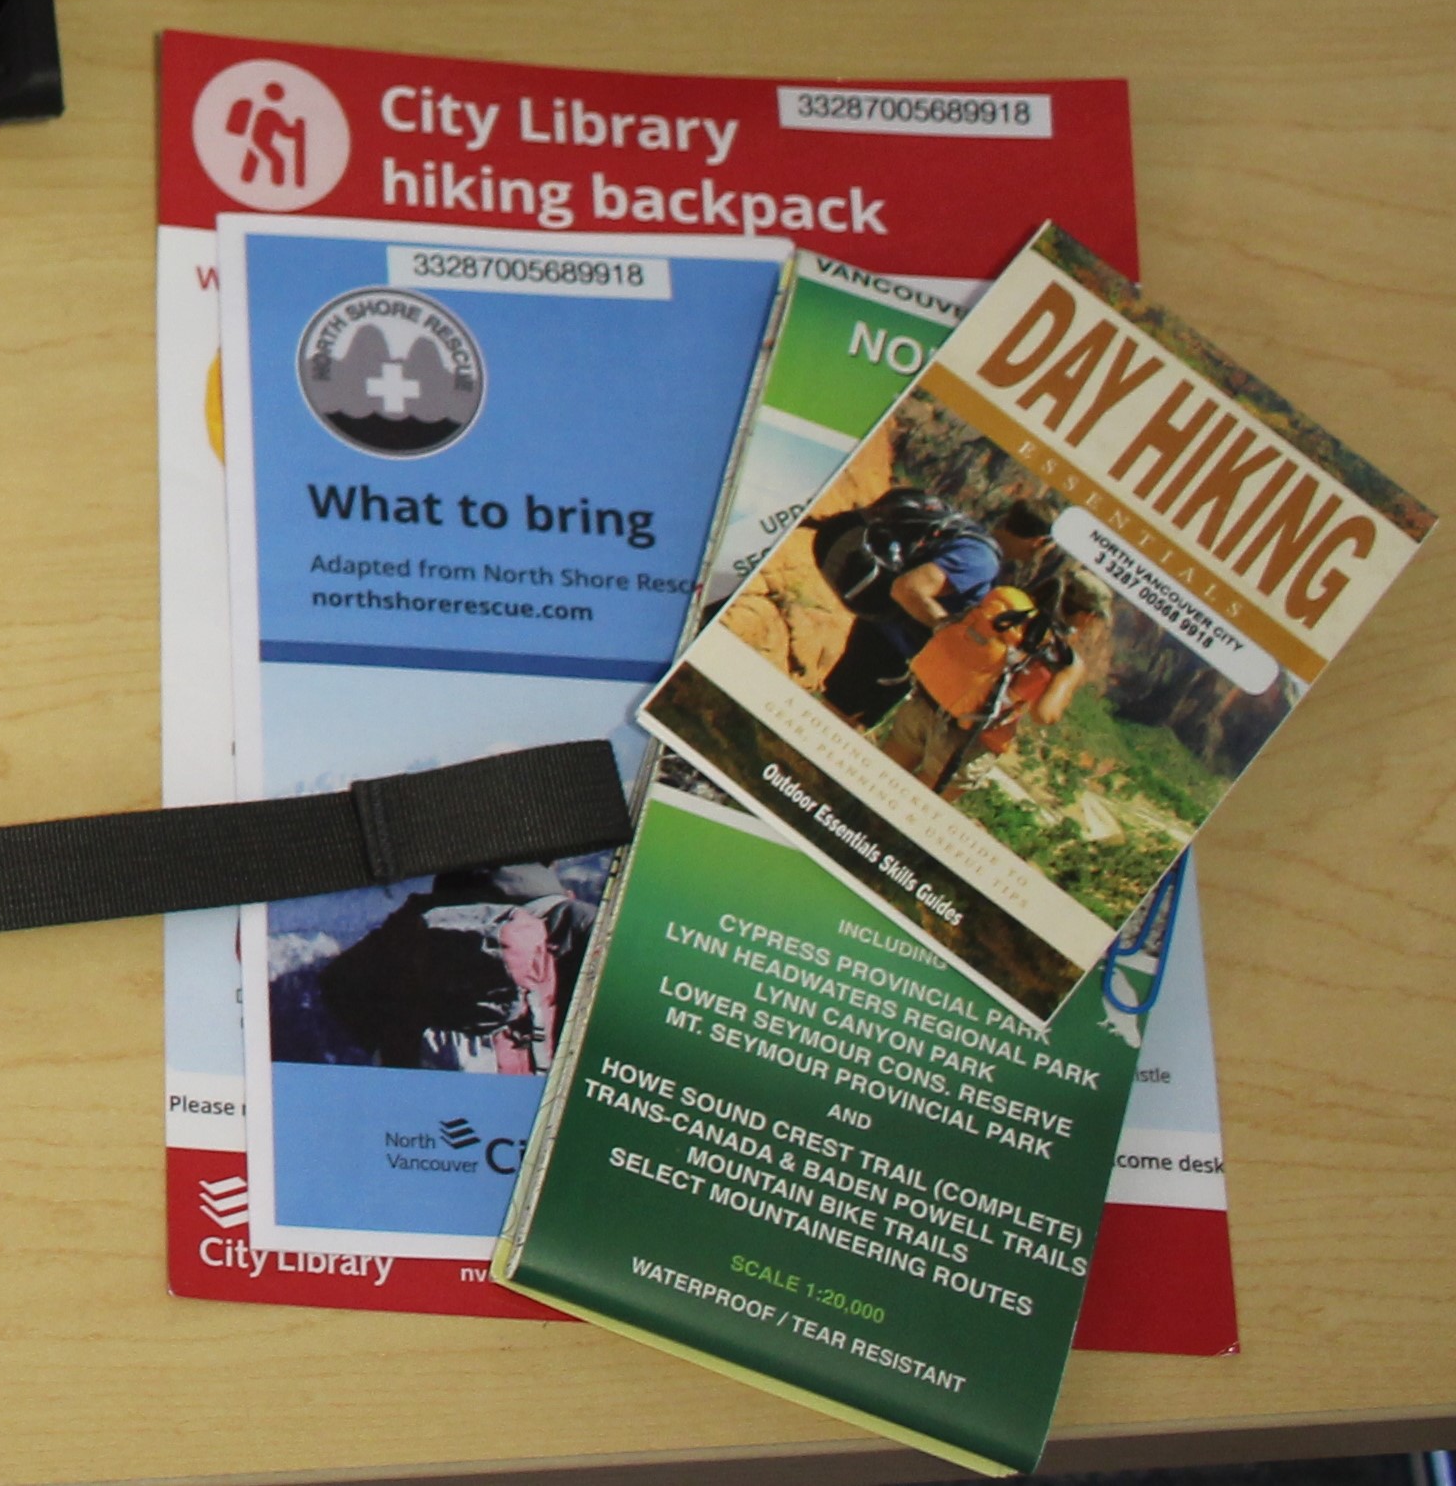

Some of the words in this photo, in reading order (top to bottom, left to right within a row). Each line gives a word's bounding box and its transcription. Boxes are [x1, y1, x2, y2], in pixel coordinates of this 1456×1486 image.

[379, 85, 501, 152] City
[520, 97, 740, 166] Library
[796, 92, 1032, 126] 33287005689918
[383, 157, 576, 230] hiking
[592, 172, 888, 236] backpack
[412, 251, 645, 288] 33287005689918
[343, 298, 424, 324] SHORE
[422, 314, 476, 393] RESCUE
[975, 278, 1167, 450] DAY
[1106, 377, 1378, 632] HIKING
[307, 483, 443, 527] What
[457, 491, 509, 530] to
[525, 493, 657, 549] bring
[1016, 439, 1243, 618] ESSENTIALS
[310, 554, 410, 581] Adapted
[419, 557, 476, 581] from
[482, 562, 554, 587] North
[560, 567, 630, 591] Shore
[311, 587, 594, 622] northshorerescue.com
[1089, 528, 1135, 568] NORTH
[1134, 563, 1213, 630] VANCOUVER
[1211, 625, 1245, 652] CITY
[1094, 551, 1107, 565] 3
[1104, 562, 1140, 590] 3287
[761, 762, 819, 813] Outdoor
[812, 802, 883, 865] Essentials
[877, 852, 920, 893] Skills
[914, 881, 965, 928] Guides
[665, 920, 730, 960] LYNN
[732, 945, 900, 1020] HEADWATERS
[903, 1006, 1028, 1067] REGIONAL
[1033, 1052, 1102, 1092] PARK
[718, 912, 832, 968] CYPRESS
[835, 954, 980, 1023] PROVINCIAL
[658, 974, 749, 1022] LOWER
[752, 1009, 873, 1069] SEYMOUR
[877, 1055, 952, 1097] CONS.
[957, 1082, 1074, 1139] RESERVE
[753, 981, 819, 1020] LYNN
[822, 1006, 927, 1059] CANYON
[929, 1044, 998, 1084] PARK
[169, 1095, 235, 1116] Please
[664, 1005, 704, 1037] MT.
[708, 1021, 831, 1081] SEYMOUR
[833, 1067, 981, 1136] PROVINCIAL
[985, 1120, 1055, 1161] PARK
[826, 1102, 873, 1131] AND
[384, 1131, 437, 1150] North
[386, 1153, 479, 1173] Vancouver
[584, 1077, 774, 1165] TRANS-CANADA
[778, 1150, 797, 1173] &
[802, 1158, 890, 1206] BADEN
[892, 1191, 996, 1246] POWELL
[1001, 1230, 1089, 1278] TRAILS
[600, 1055, 678, 1100] HOWE
[680, 1085, 768, 1132] SOUND
[771, 1119, 856, 1164] CREST
[859, 1149, 929, 1193] TRAIL
[933, 1176, 1084, 1250] (COMPLETE)
[1178, 1154, 1226, 1175] desk
[608, 1146, 706, 1196] SELECT
[708, 1182, 927, 1279] MOUNTAINEERING
[931, 1264, 1035, 1317] ROUTES
[686, 1145, 816, 1208] MOUNTAIN
[818, 1194, 878, 1231] BIKE
[882, 1215, 970, 1264] TRAILS
[198, 1235, 269, 1279] City
[276, 1251, 395, 1287] Library
[729, 1254, 801, 1293] SCALE
[804, 1281, 886, 1325] 1:20,000
[630, 1255, 778, 1322] WATERPROOF
[775, 1311, 791, 1327] /
[790, 1314, 848, 1351] TEAR
[849, 1337, 968, 1395] RESISTANT
